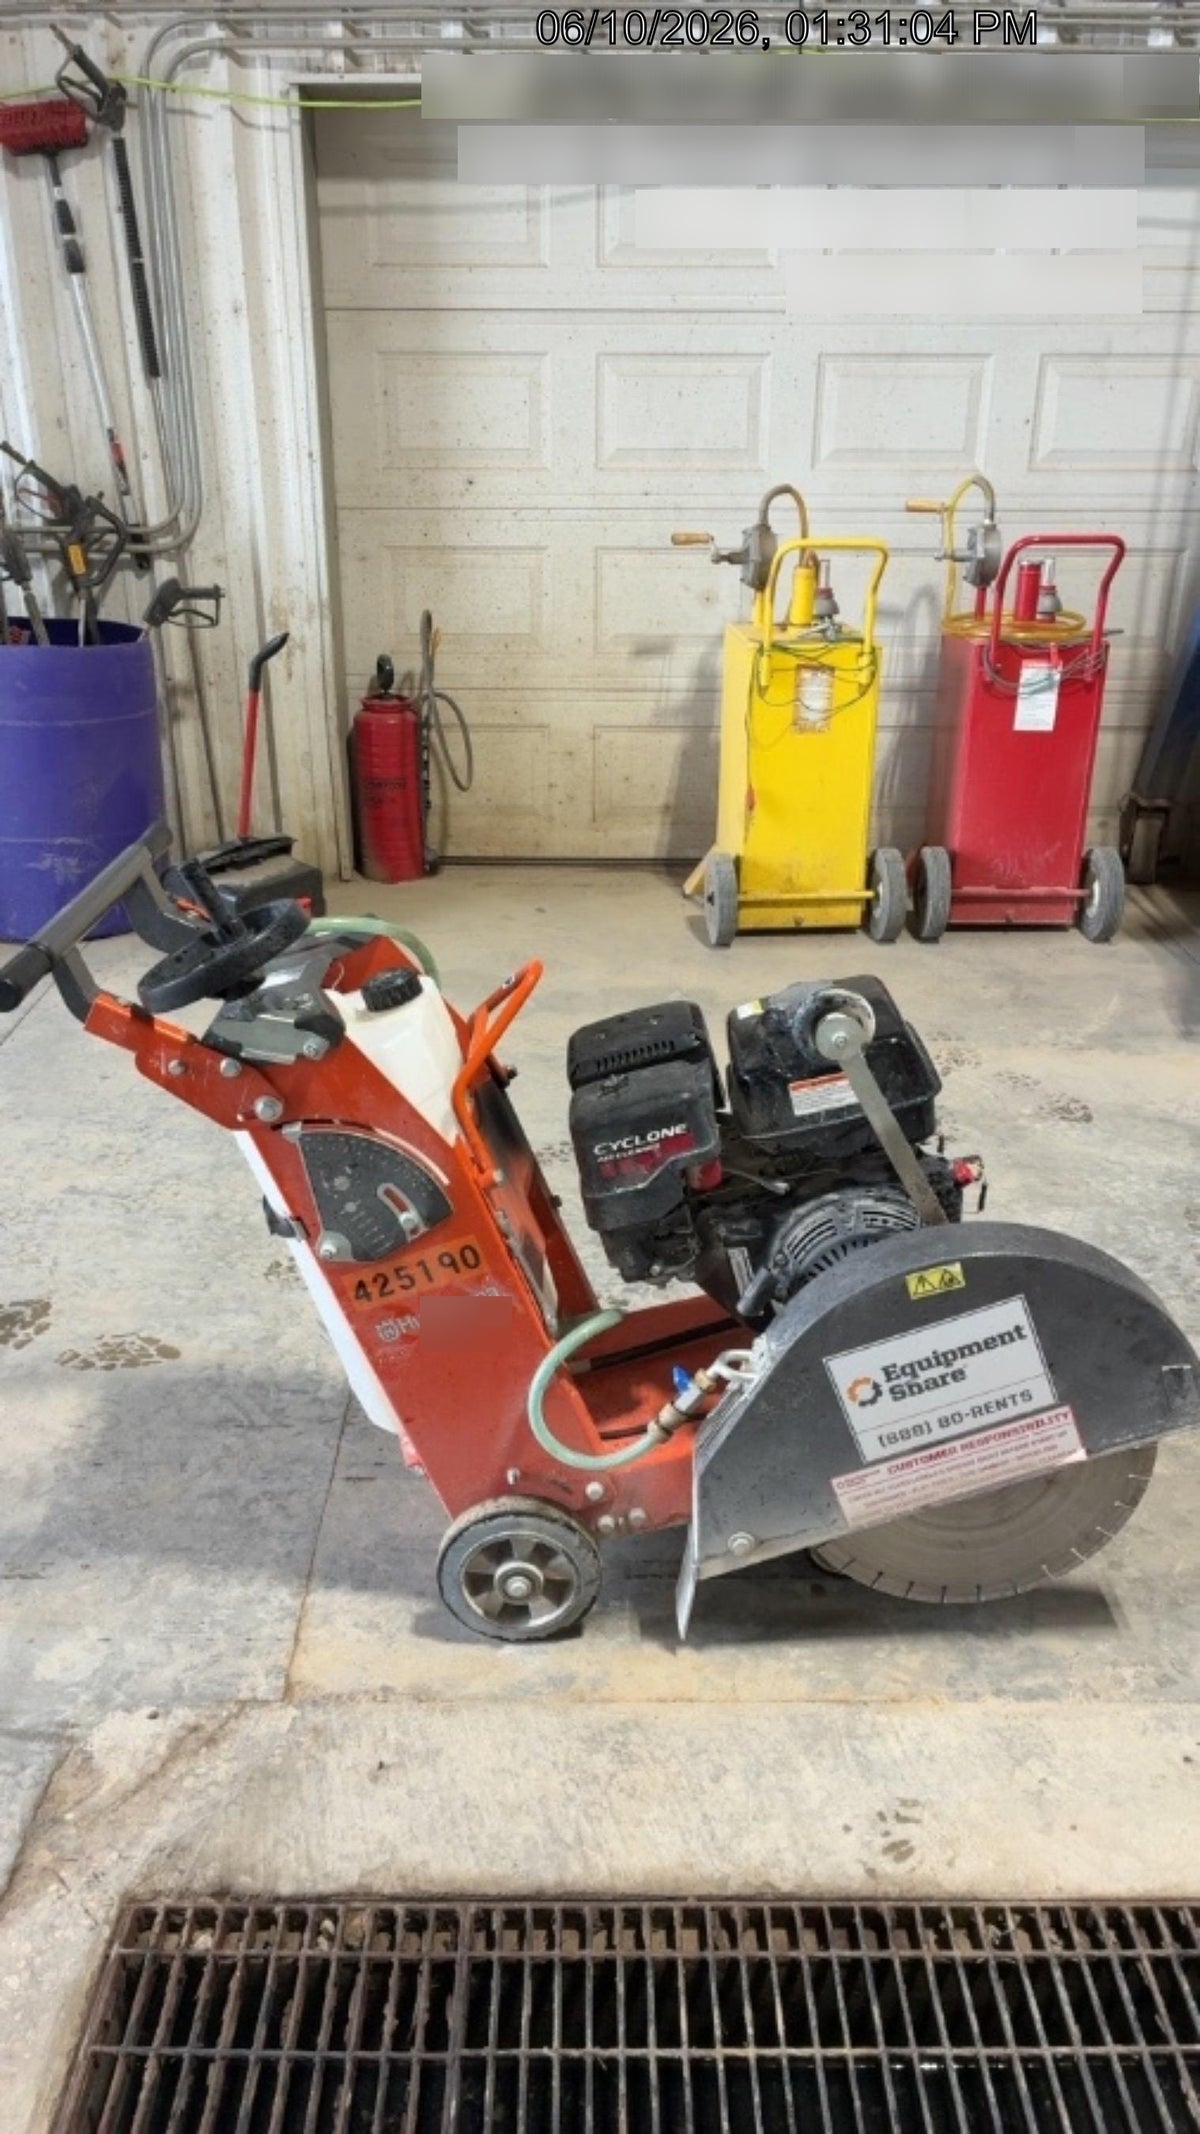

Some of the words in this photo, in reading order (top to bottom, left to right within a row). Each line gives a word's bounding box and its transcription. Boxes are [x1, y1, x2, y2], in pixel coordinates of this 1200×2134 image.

[593, 1123, 688, 1156] CYCLONE
[354, 1244, 480, 1303] 425190
[881, 1323, 1028, 1384] Equipment
[888, 1366, 968, 1403] Share
[877, 1420, 933, 1449] (888)
[937, 1388, 1034, 1429] 80-RENTS
[887, 1444, 958, 1476] CUSTOMER
[959, 1410, 1071, 1452] RESPONSIBILITY
